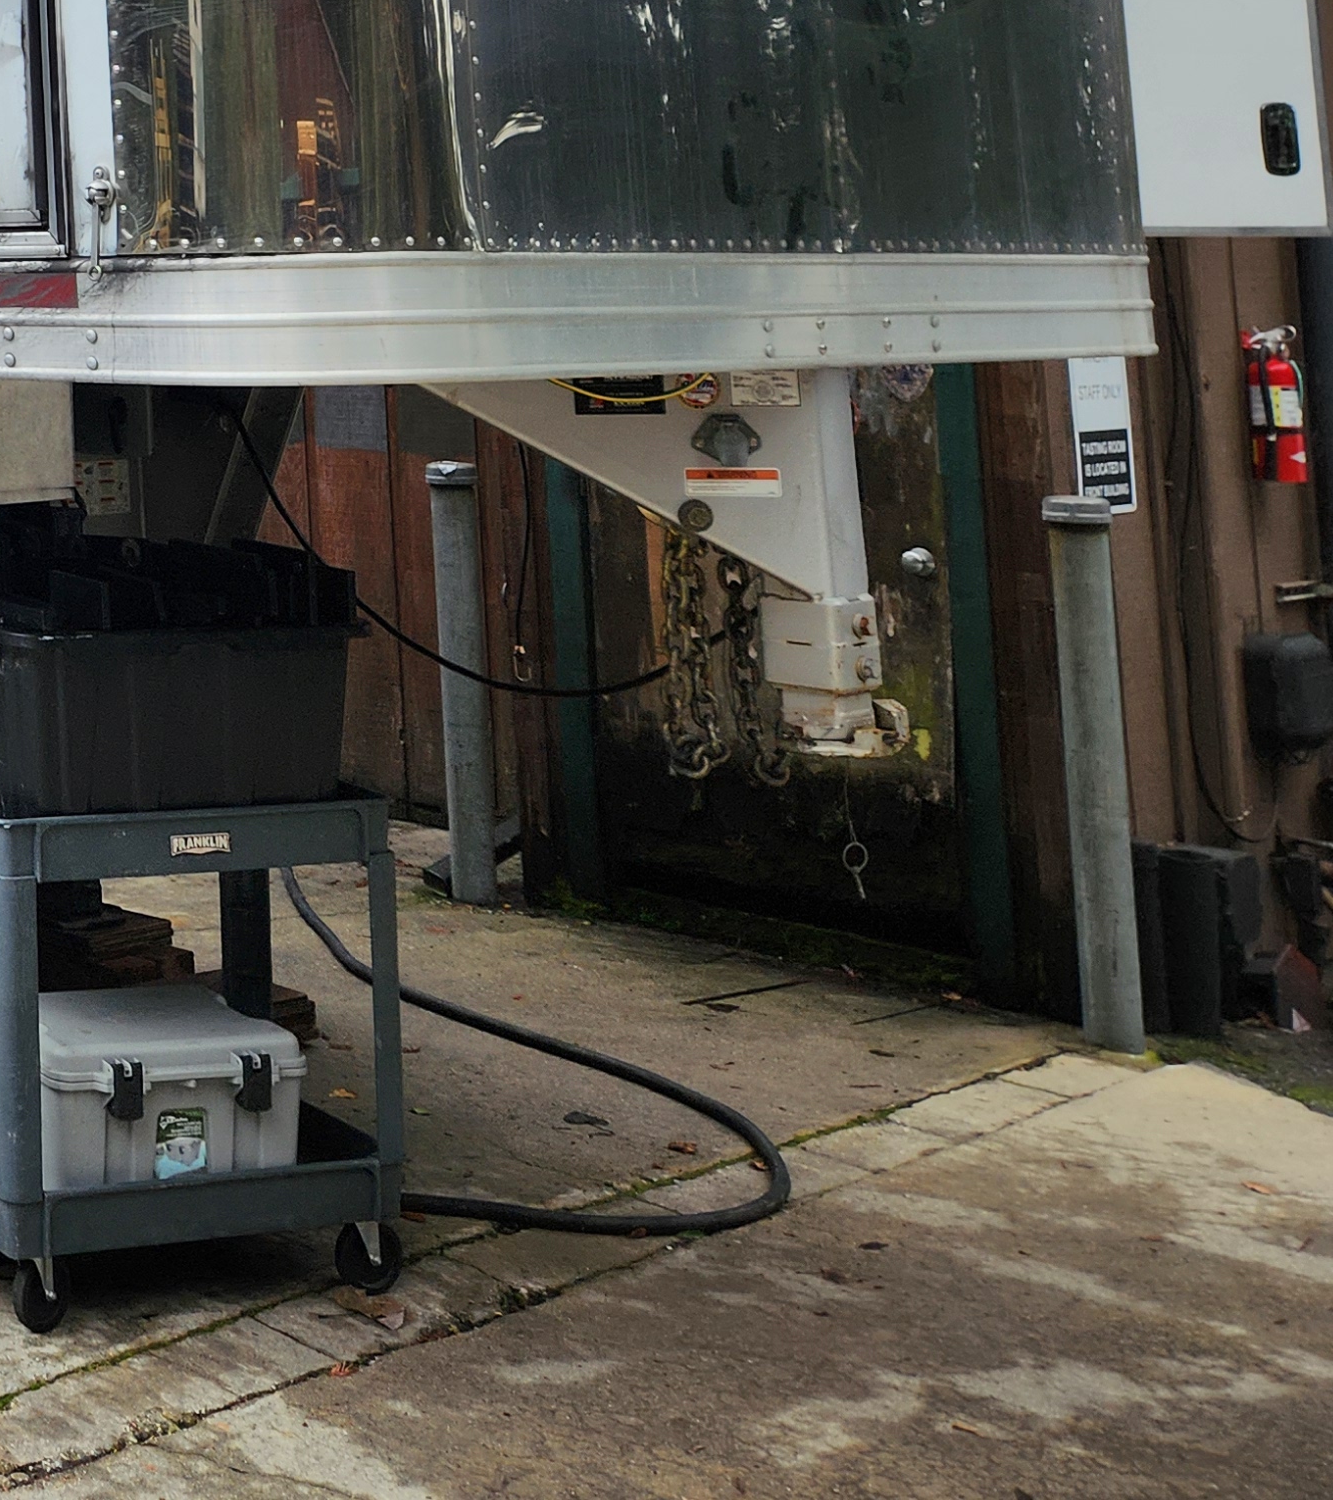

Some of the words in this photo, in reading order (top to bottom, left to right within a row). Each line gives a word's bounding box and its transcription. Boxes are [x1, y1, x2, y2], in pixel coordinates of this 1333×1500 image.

[1078, 384, 1100, 400] STAFF
[1102, 383, 1121, 399] ONLY
[1082, 441, 1108, 456] TASTING
[1108, 440, 1126, 453] ROOM
[1092, 461, 1119, 477] LOCATED
[173, 835, 228, 853] FRANKLIN
